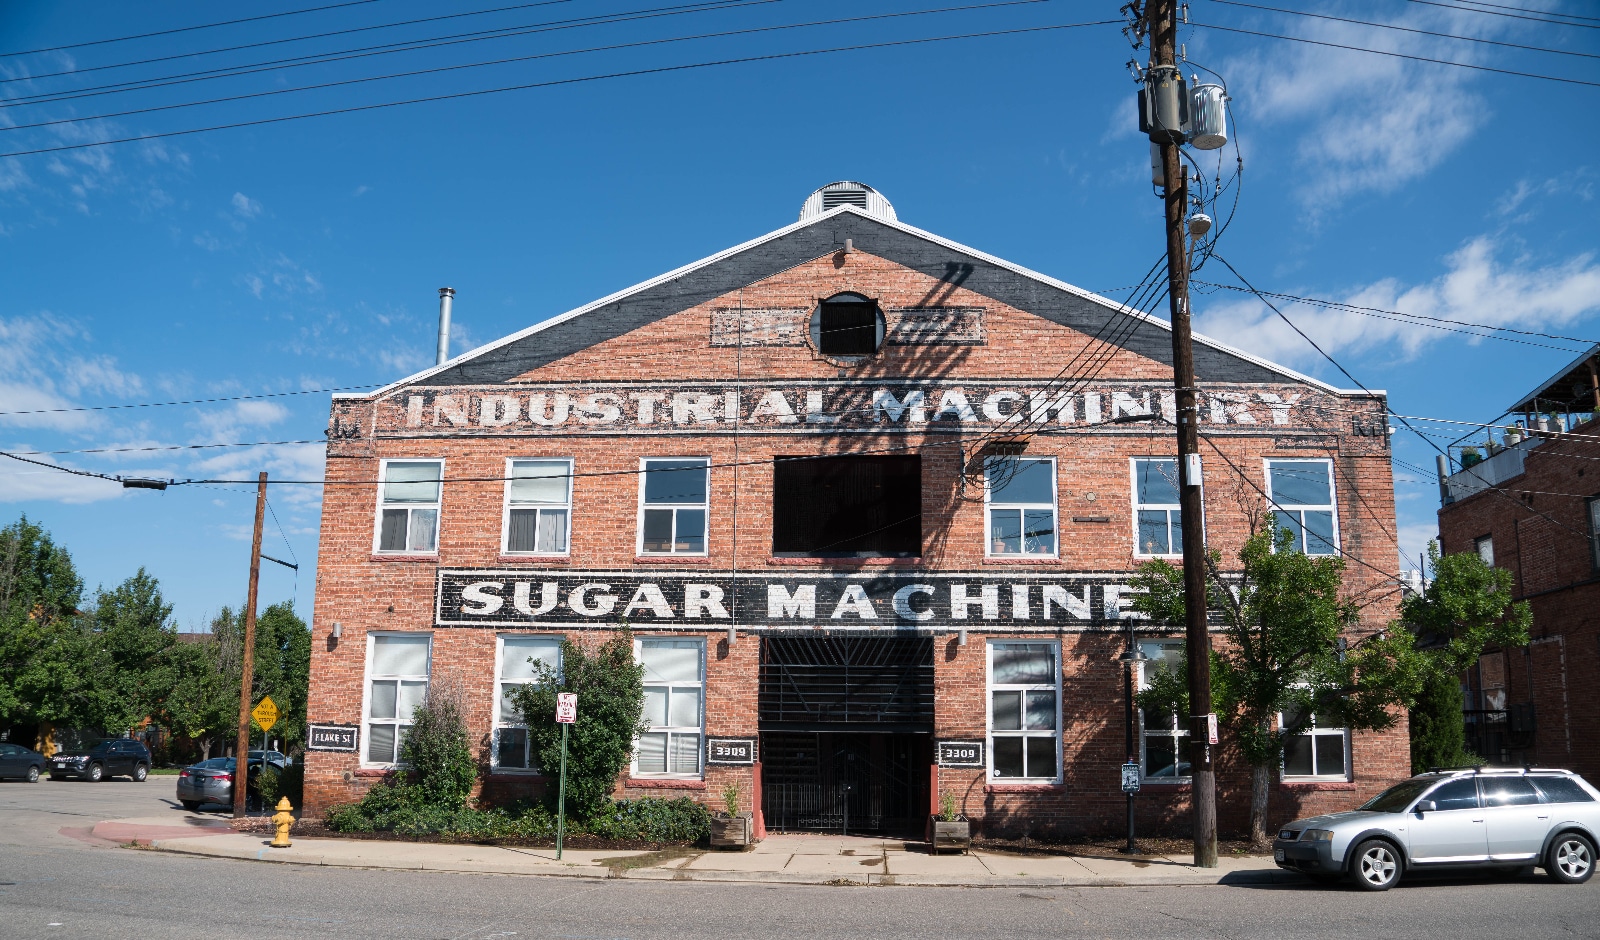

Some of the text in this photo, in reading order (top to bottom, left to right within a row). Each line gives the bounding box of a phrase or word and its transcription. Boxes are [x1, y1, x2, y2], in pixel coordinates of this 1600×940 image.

[406, 390, 841, 428] INDUSTRIAL
[461, 581, 730, 619] SUGAR
[315, 733, 340, 742] FLAKE
[716, 747, 746, 757] 3309
[946, 748, 975, 758] 3309
